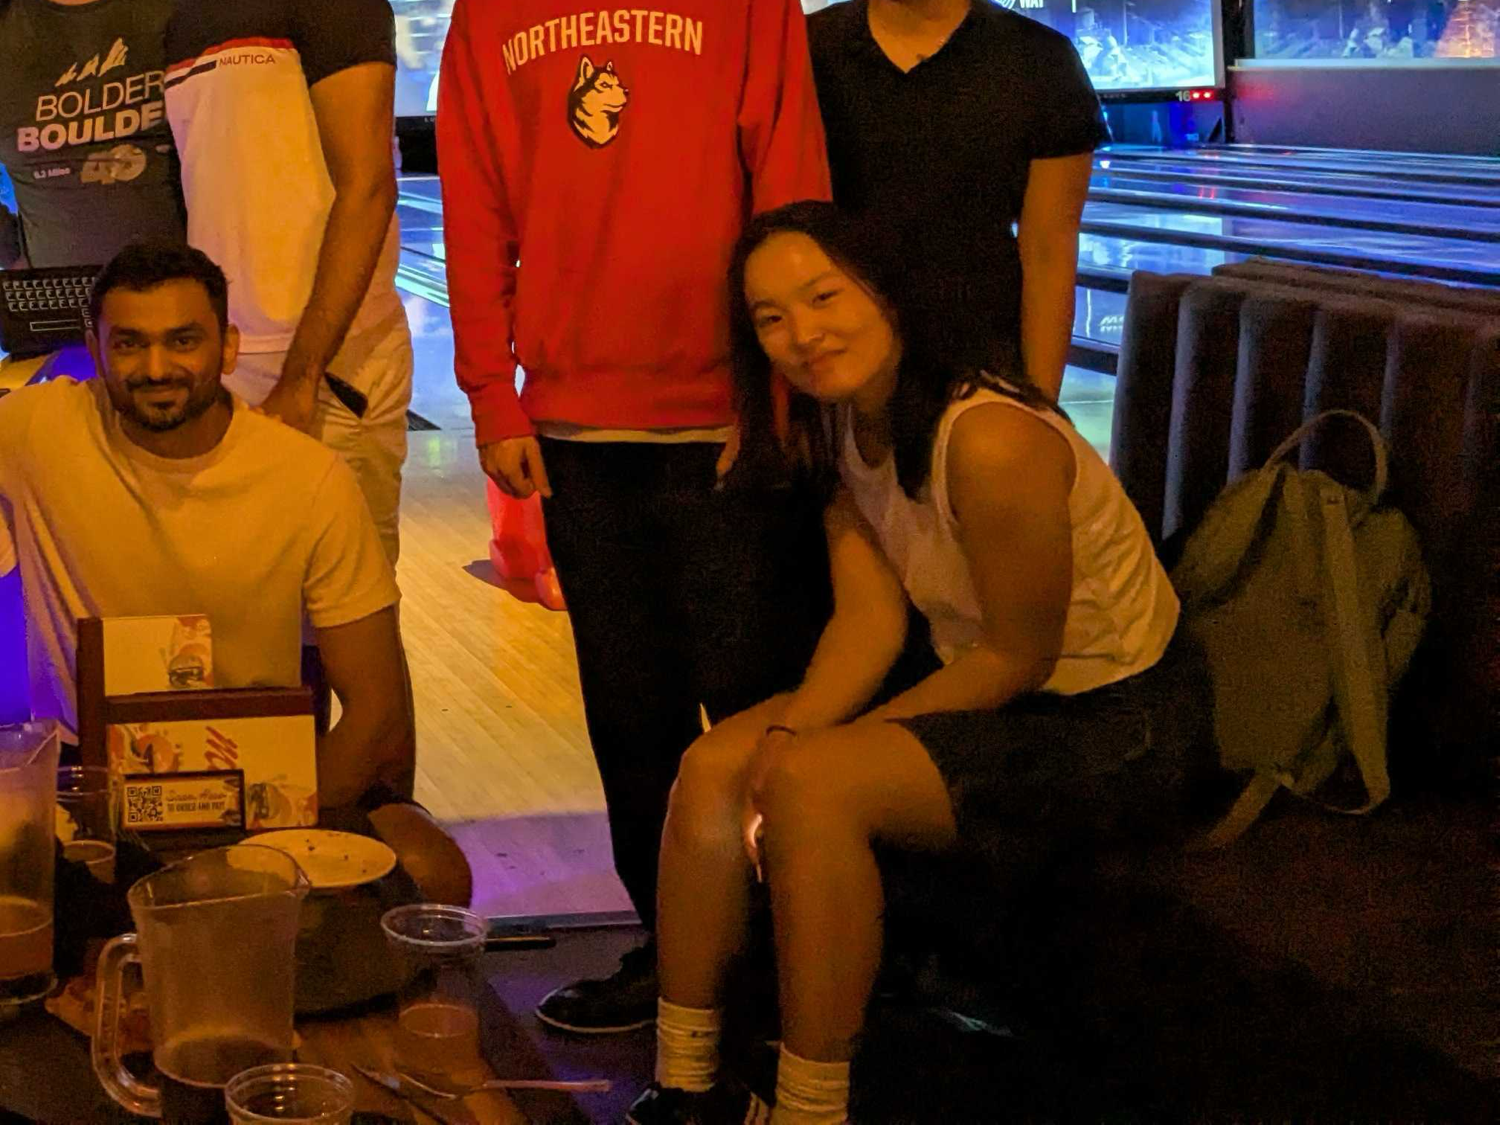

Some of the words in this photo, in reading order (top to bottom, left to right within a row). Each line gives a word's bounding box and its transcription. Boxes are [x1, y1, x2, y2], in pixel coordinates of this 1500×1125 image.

[220, 54, 276, 65] NAUTICA
[502, 9, 703, 75] NORTHEASTERN
[36, 70, 165, 121] BOLDER
[1175, 90, 1190, 102] 16
[17, 100, 165, 152] BOULDE
